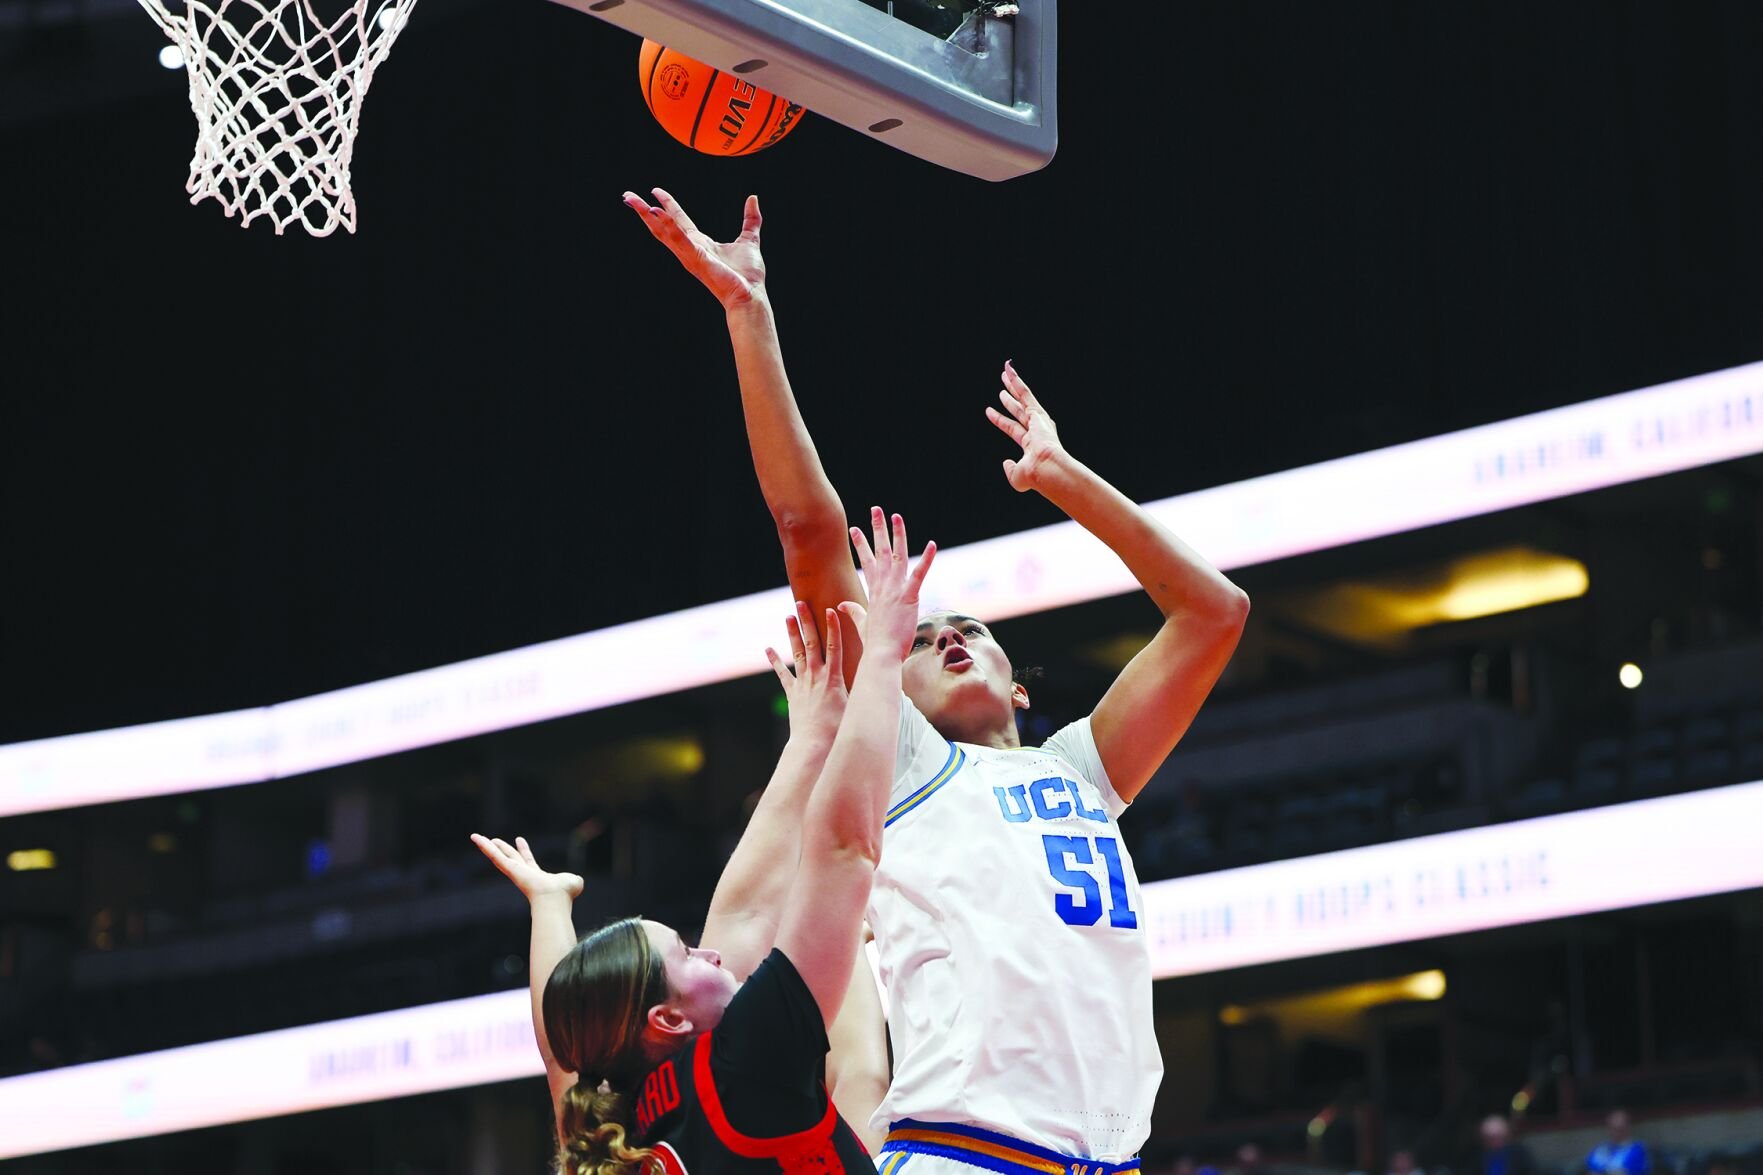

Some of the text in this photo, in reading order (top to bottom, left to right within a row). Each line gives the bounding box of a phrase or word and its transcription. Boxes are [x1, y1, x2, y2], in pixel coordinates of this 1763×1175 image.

[719, 78, 757, 138] EVO
[993, 776, 1109, 823] UCL
[1041, 834, 1138, 930] 51
